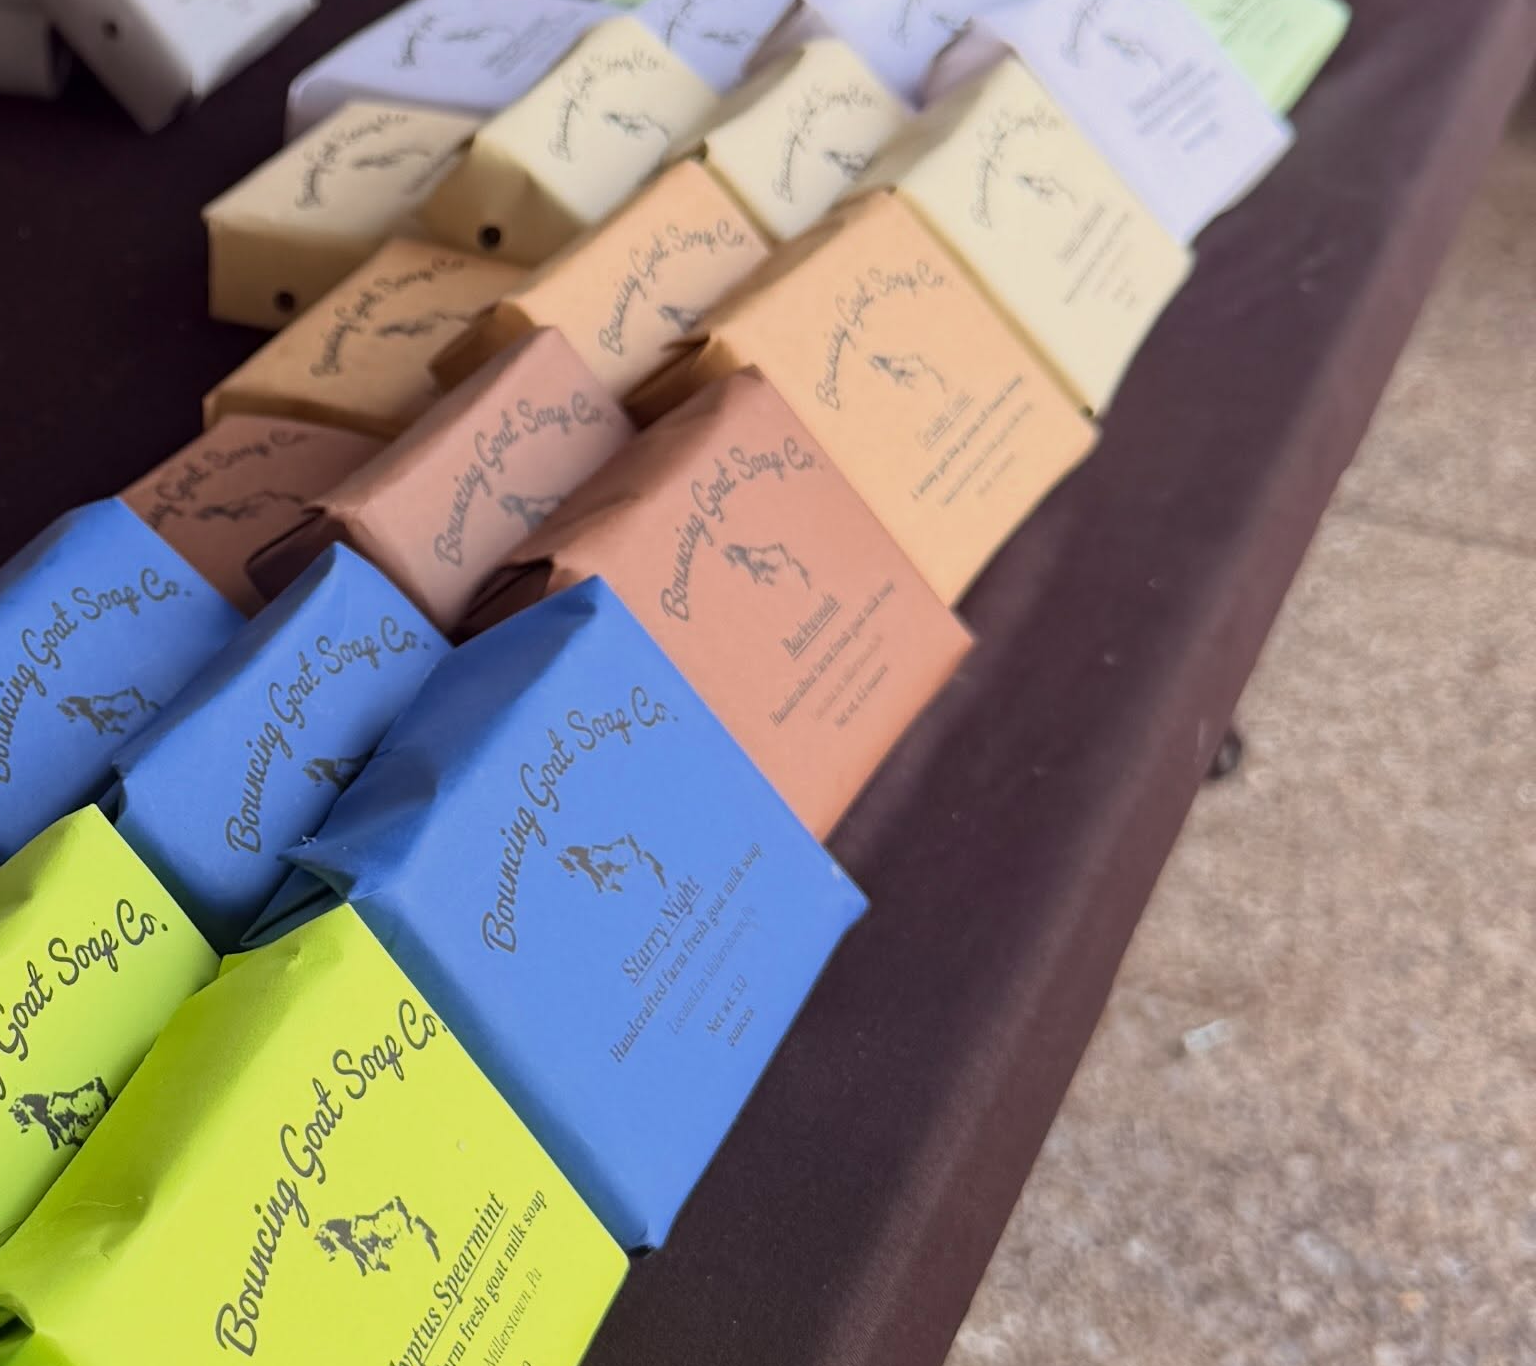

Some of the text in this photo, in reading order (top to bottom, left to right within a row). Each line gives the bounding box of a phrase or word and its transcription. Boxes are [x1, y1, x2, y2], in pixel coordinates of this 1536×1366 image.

[661, 513, 714, 622] Bouncing
[691, 460, 736, 521] Goat
[21, 601, 78, 670] Goat
[73, 587, 140, 621] Soap
[140, 567, 192, 602] Co.
[225, 615, 430, 855] Bouncing Goat Soap Co.
[481, 686, 679, 954] Bouncing Goat Soap Co.
[48, 928, 119, 984] Soap
[116, 898, 169, 948] Co.
[622, 875, 701, 984] Starry Night
[610, 978, 667, 1062] Handcrafted
[663, 954, 687, 986] farm
[216, 998, 446, 1357] Bouncing Goat Soap Co.
[433, 1190, 505, 1310] Spearmint
[459, 1296, 490, 1343] fresh
[485, 1259, 508, 1303] goat
[504, 1224, 527, 1263] milk
[522, 1189, 546, 1230] soap
